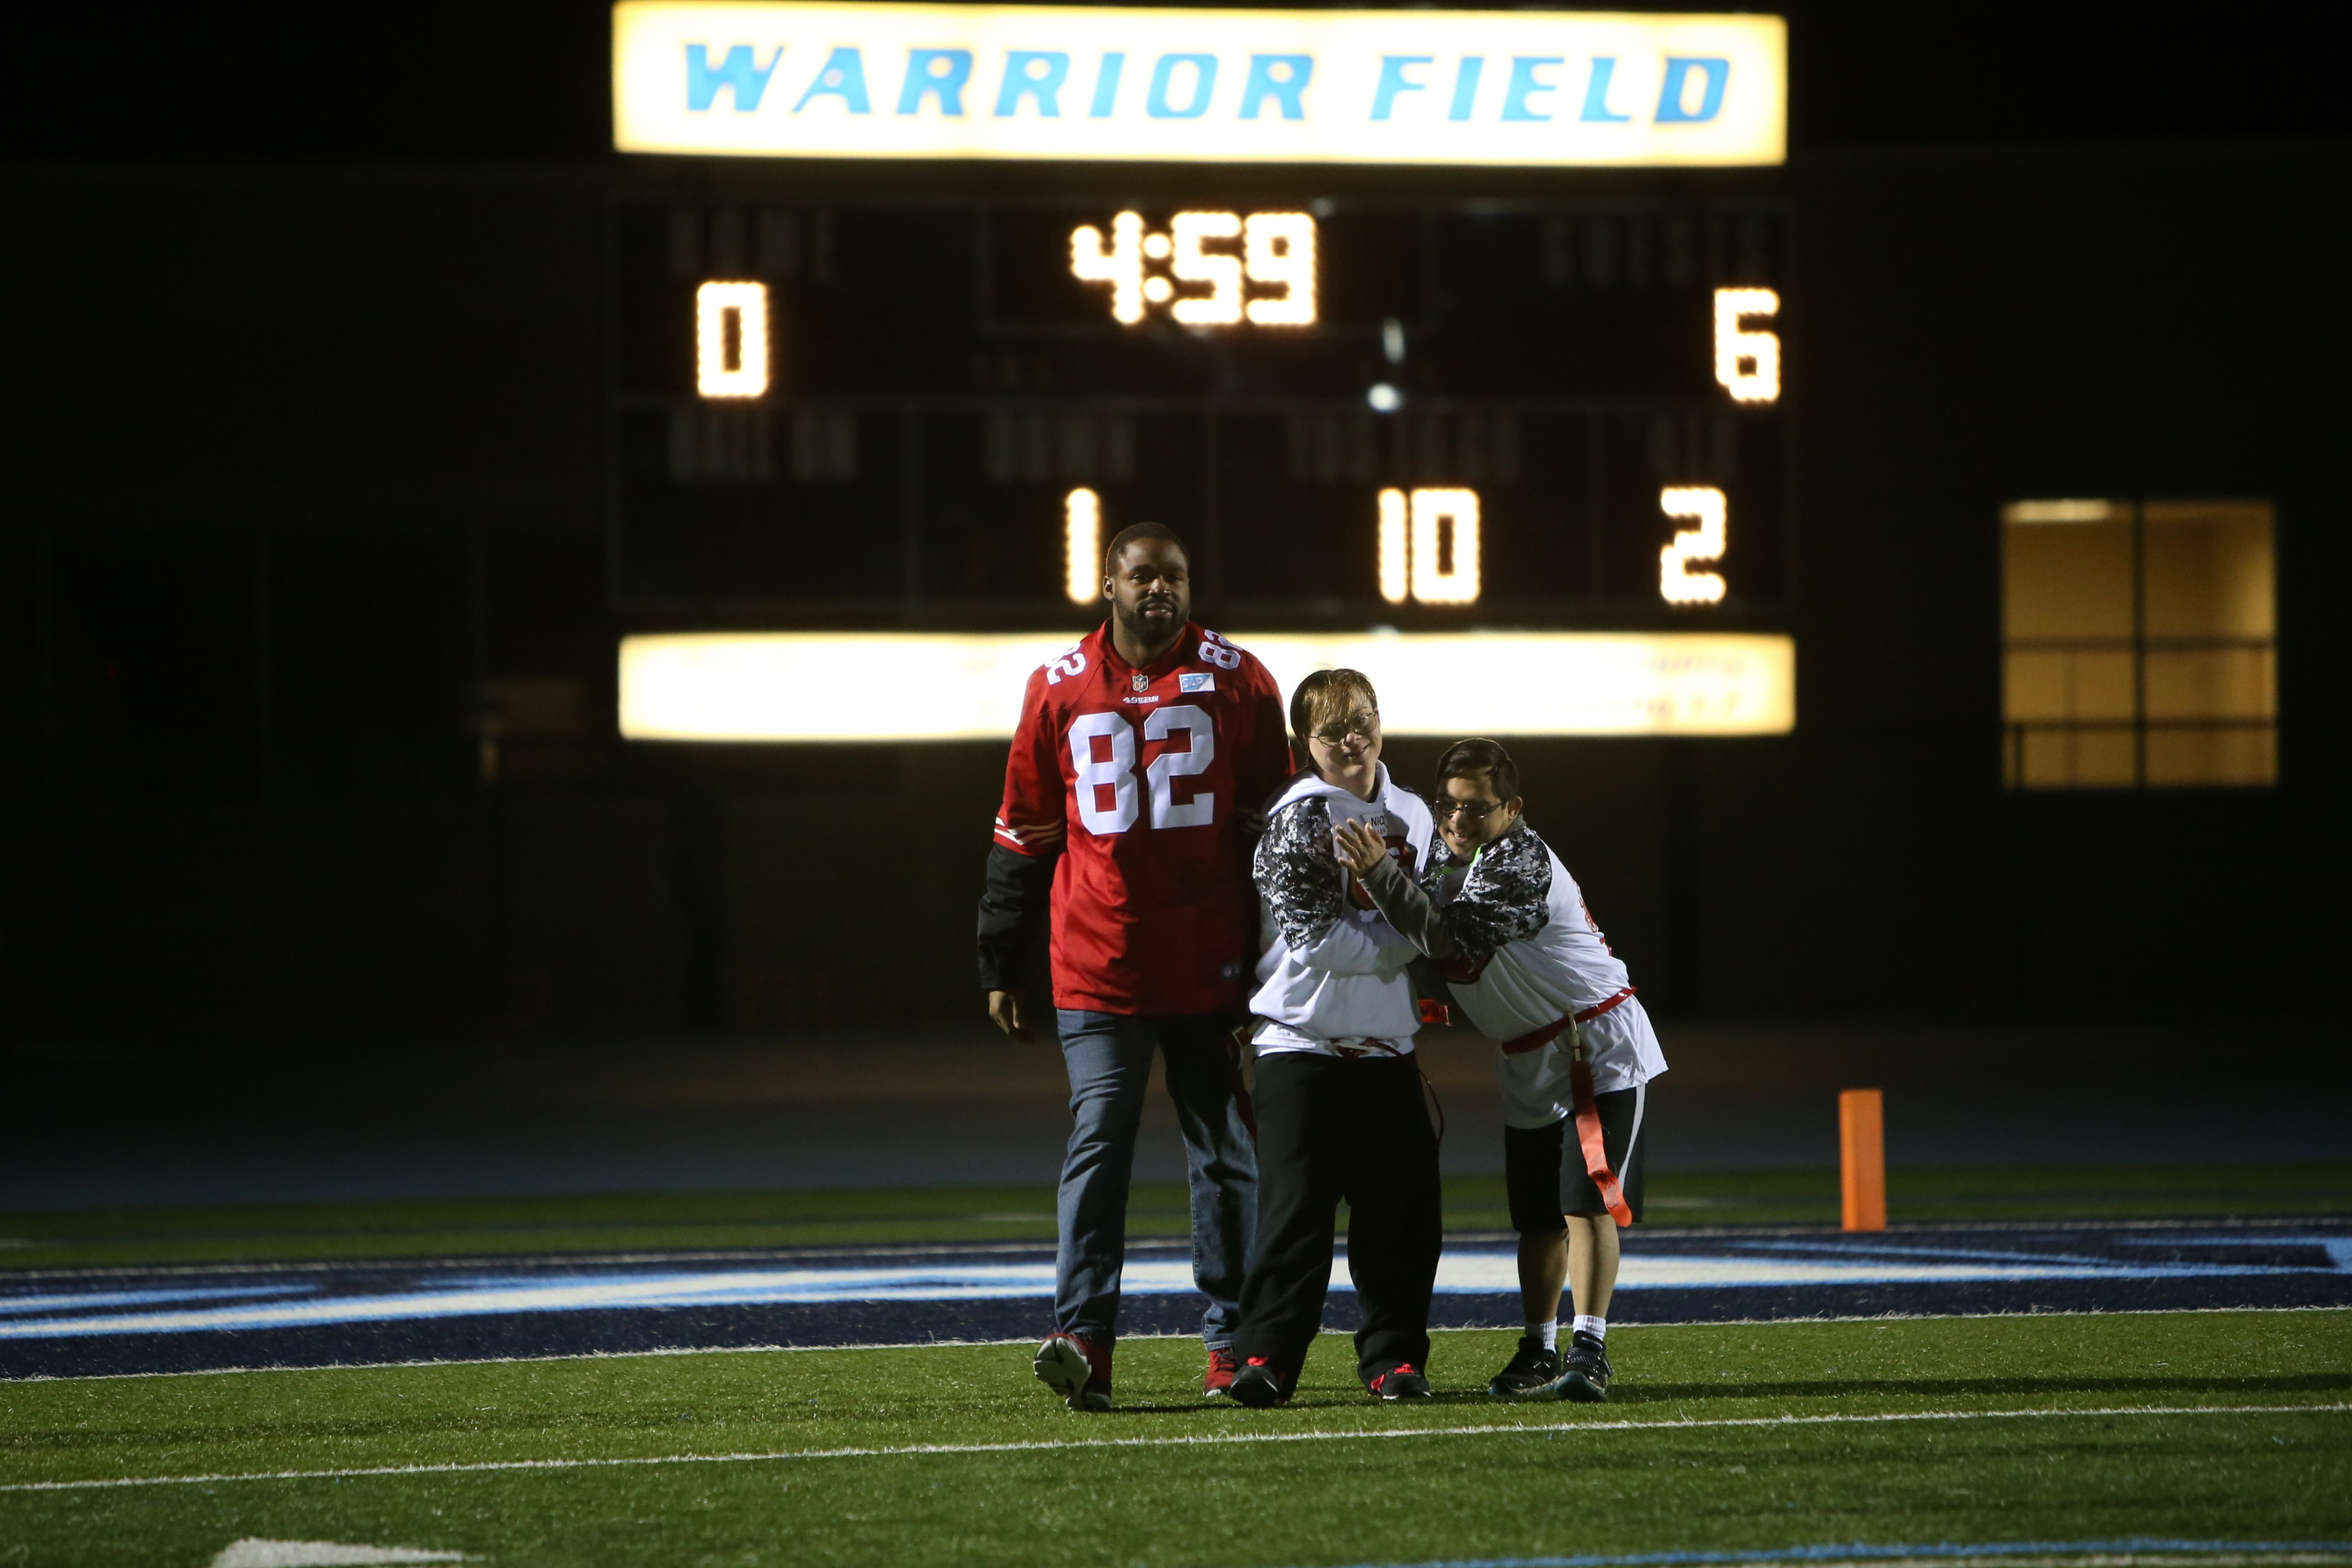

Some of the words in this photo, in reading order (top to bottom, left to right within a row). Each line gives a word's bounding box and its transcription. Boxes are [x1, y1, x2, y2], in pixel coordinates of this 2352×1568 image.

[685, 43, 1316, 121] WARRIOR
[1368, 55, 1730, 124] FIELD
[1069, 209, 1318, 326] 4:59
[695, 280, 771, 400] 0
[1714, 287, 1780, 404] 6
[1065, 487, 1102, 606] 1
[1377, 487, 1481, 606] 10
[1660, 485, 1727, 606] 2
[1068, 704, 1214, 836] 82
